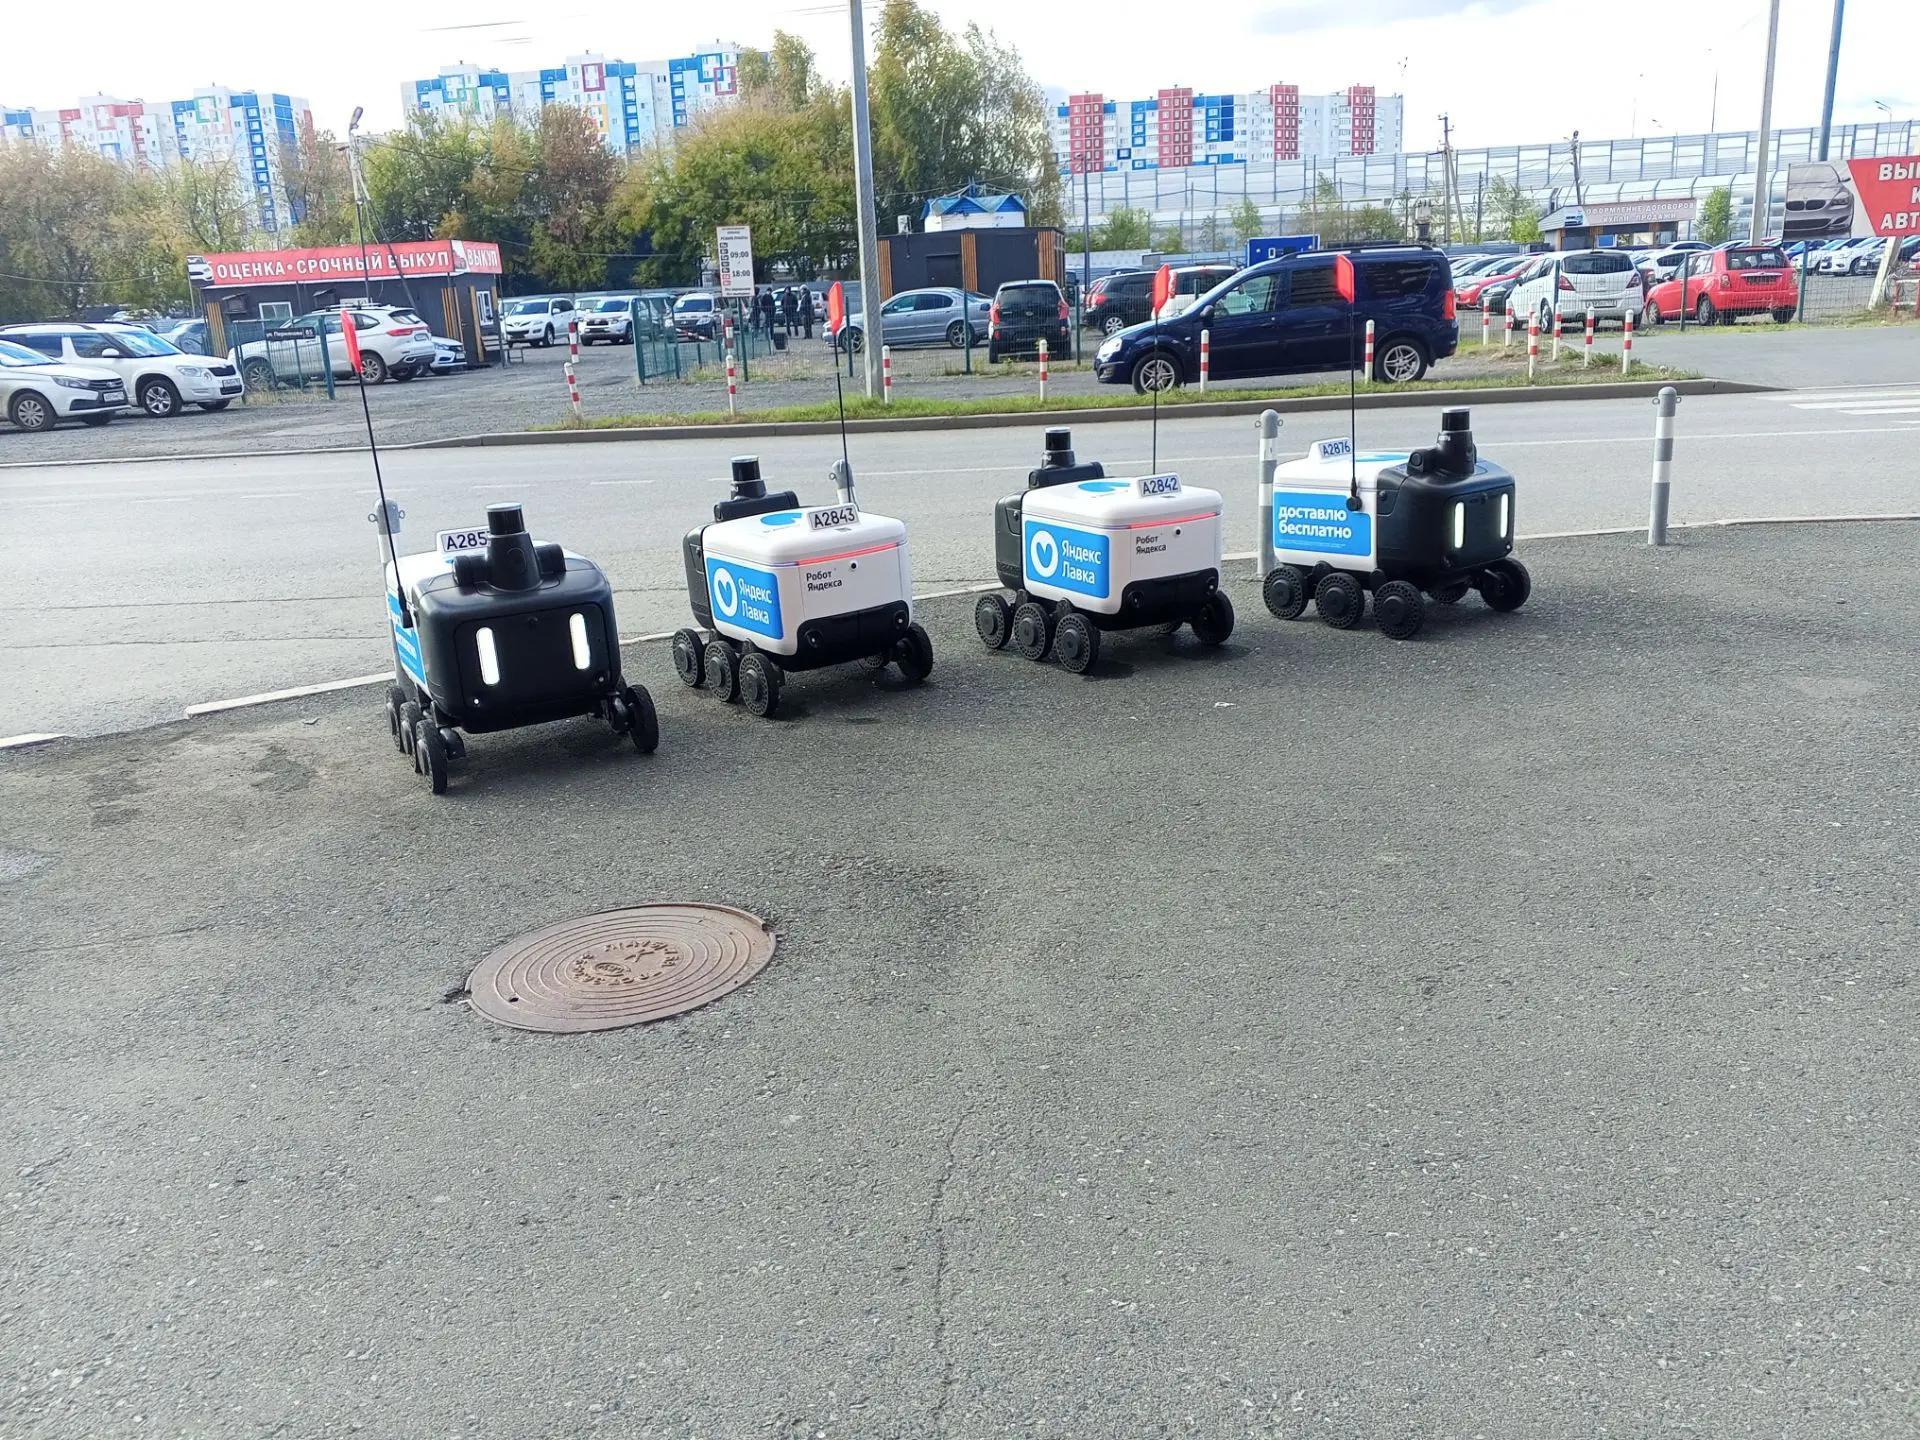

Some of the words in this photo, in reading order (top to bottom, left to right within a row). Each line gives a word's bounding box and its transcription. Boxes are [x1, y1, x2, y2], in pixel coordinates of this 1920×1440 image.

[1879, 161, 1920, 181] ВЫ
[1645, 202, 1694, 212] ДОГОВОРОВ
[216, 261, 286, 280] ОЦЕНКА
[296, 252, 384, 275] СРОЧНЫЙ
[388, 251, 449, 269] ВЫКУП
[467, 249, 498, 267] ВЫКУП
[1279, 505, 1348, 523] доставлю
[1279, 522, 1352, 539] бесплатно
[446, 530, 491, 550] А285
[1136, 535, 1159, 545] Робот
[1136, 544, 1166, 553] Яндекса
[1061, 539, 1102, 566] Яндекс
[806, 571, 832, 582] Робот
[1061, 562, 1095, 585] Лавка
[737, 577, 773, 605] Яндекс
[807, 579, 842, 592] Яндекса
[741, 602, 770, 625] Лавка
